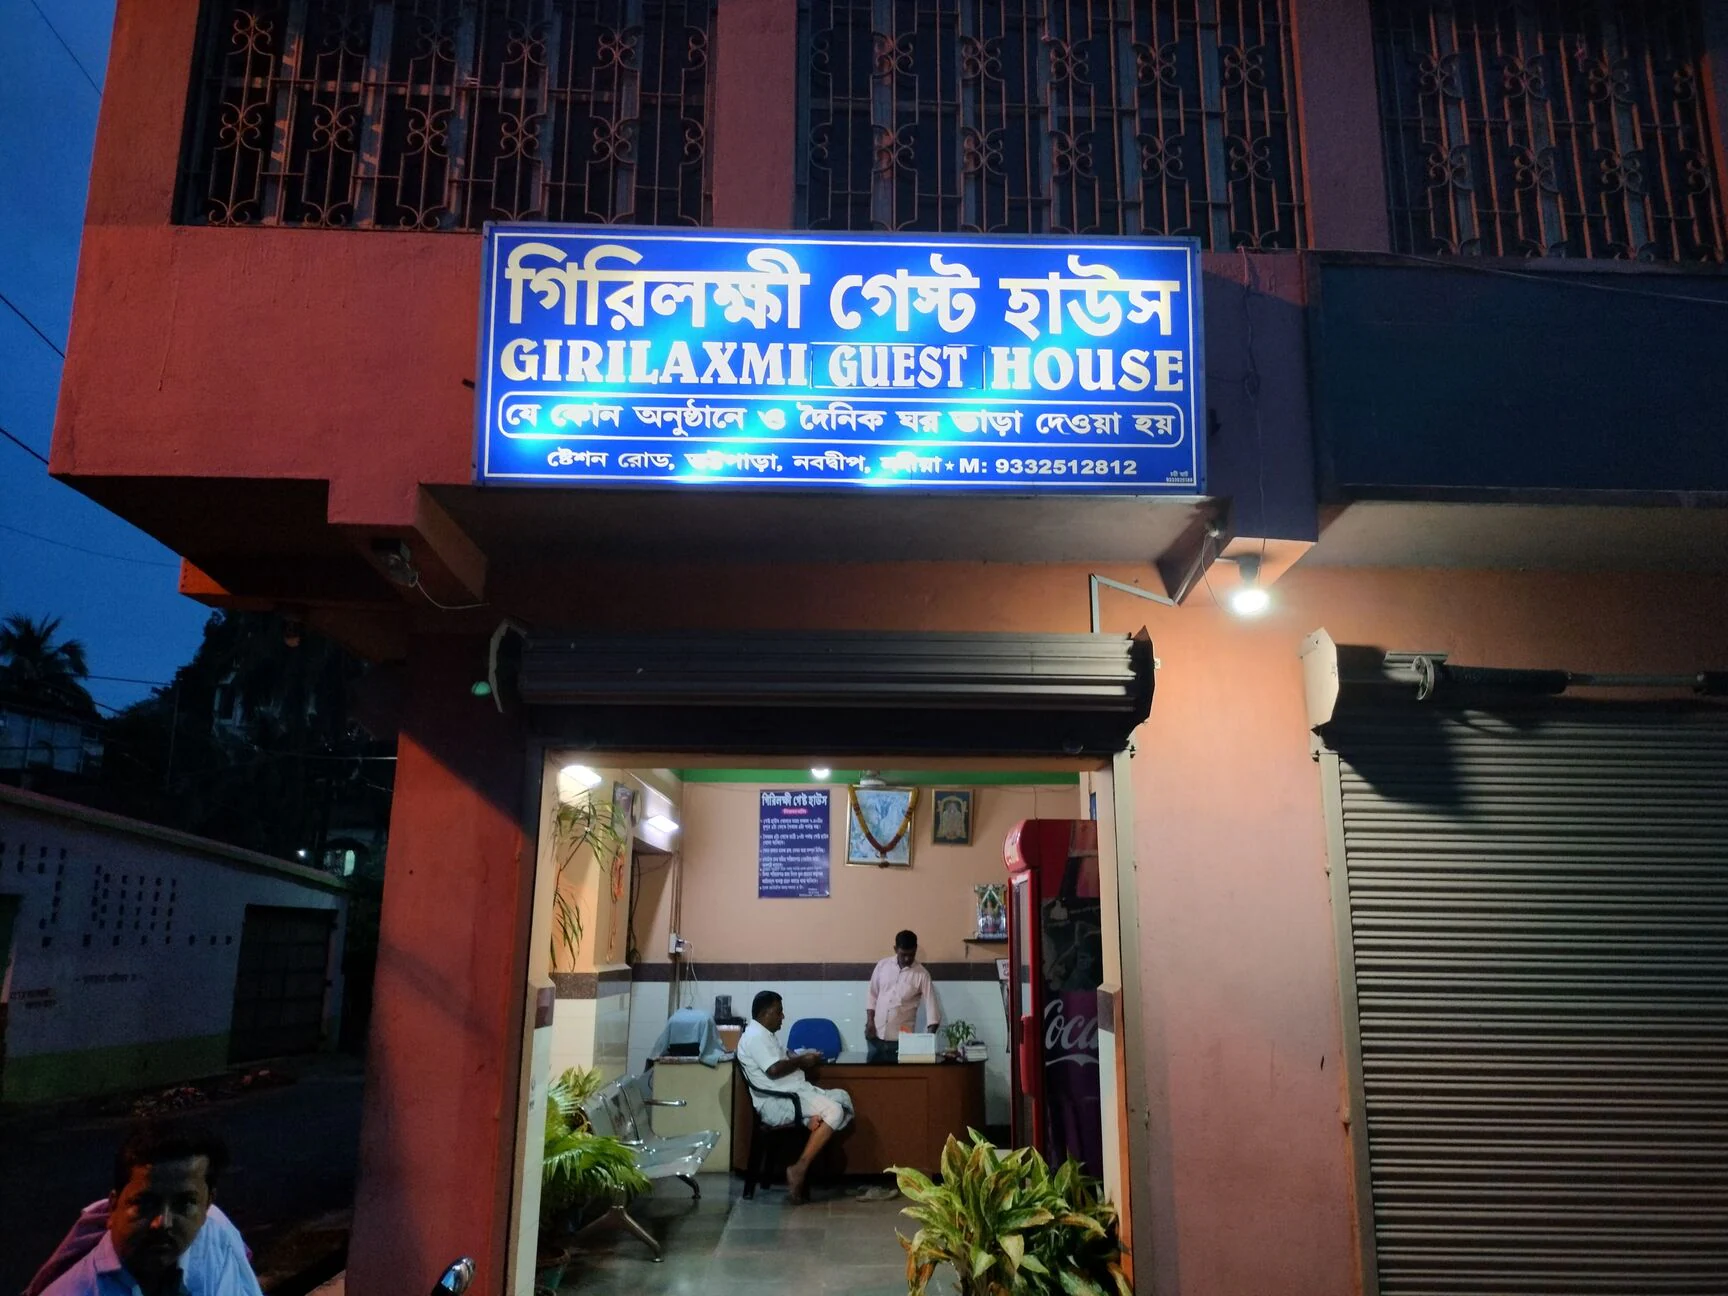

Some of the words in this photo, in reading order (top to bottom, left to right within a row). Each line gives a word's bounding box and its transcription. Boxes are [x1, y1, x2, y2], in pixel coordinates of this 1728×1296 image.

[829, 252, 981, 334] গেস্ট
[998, 253, 1181, 342] হাউস
[500, 337, 808, 386] GIRILAXMI
[828, 344, 968, 388] GUEST
[990, 346, 1184, 393] HOUSE
[506, 402, 542, 428] যে
[550, 402, 625, 429] কোন
[632, 398, 748, 437] অনুষ্ঠানে
[796, 400, 888, 433] দৈনিক
[896, 409, 941, 433] ঘর
[948, 408, 1024, 437] ভাড়া
[1036, 411, 1122, 436] দেওয়া
[1131, 412, 1176, 438] হয়
[618, 451, 676, 471] রোড,
[792, 450, 871, 474] নবদ্বীপ,
[959, 458, 988, 474] M:
[995, 457, 1138, 475] 9332512812
